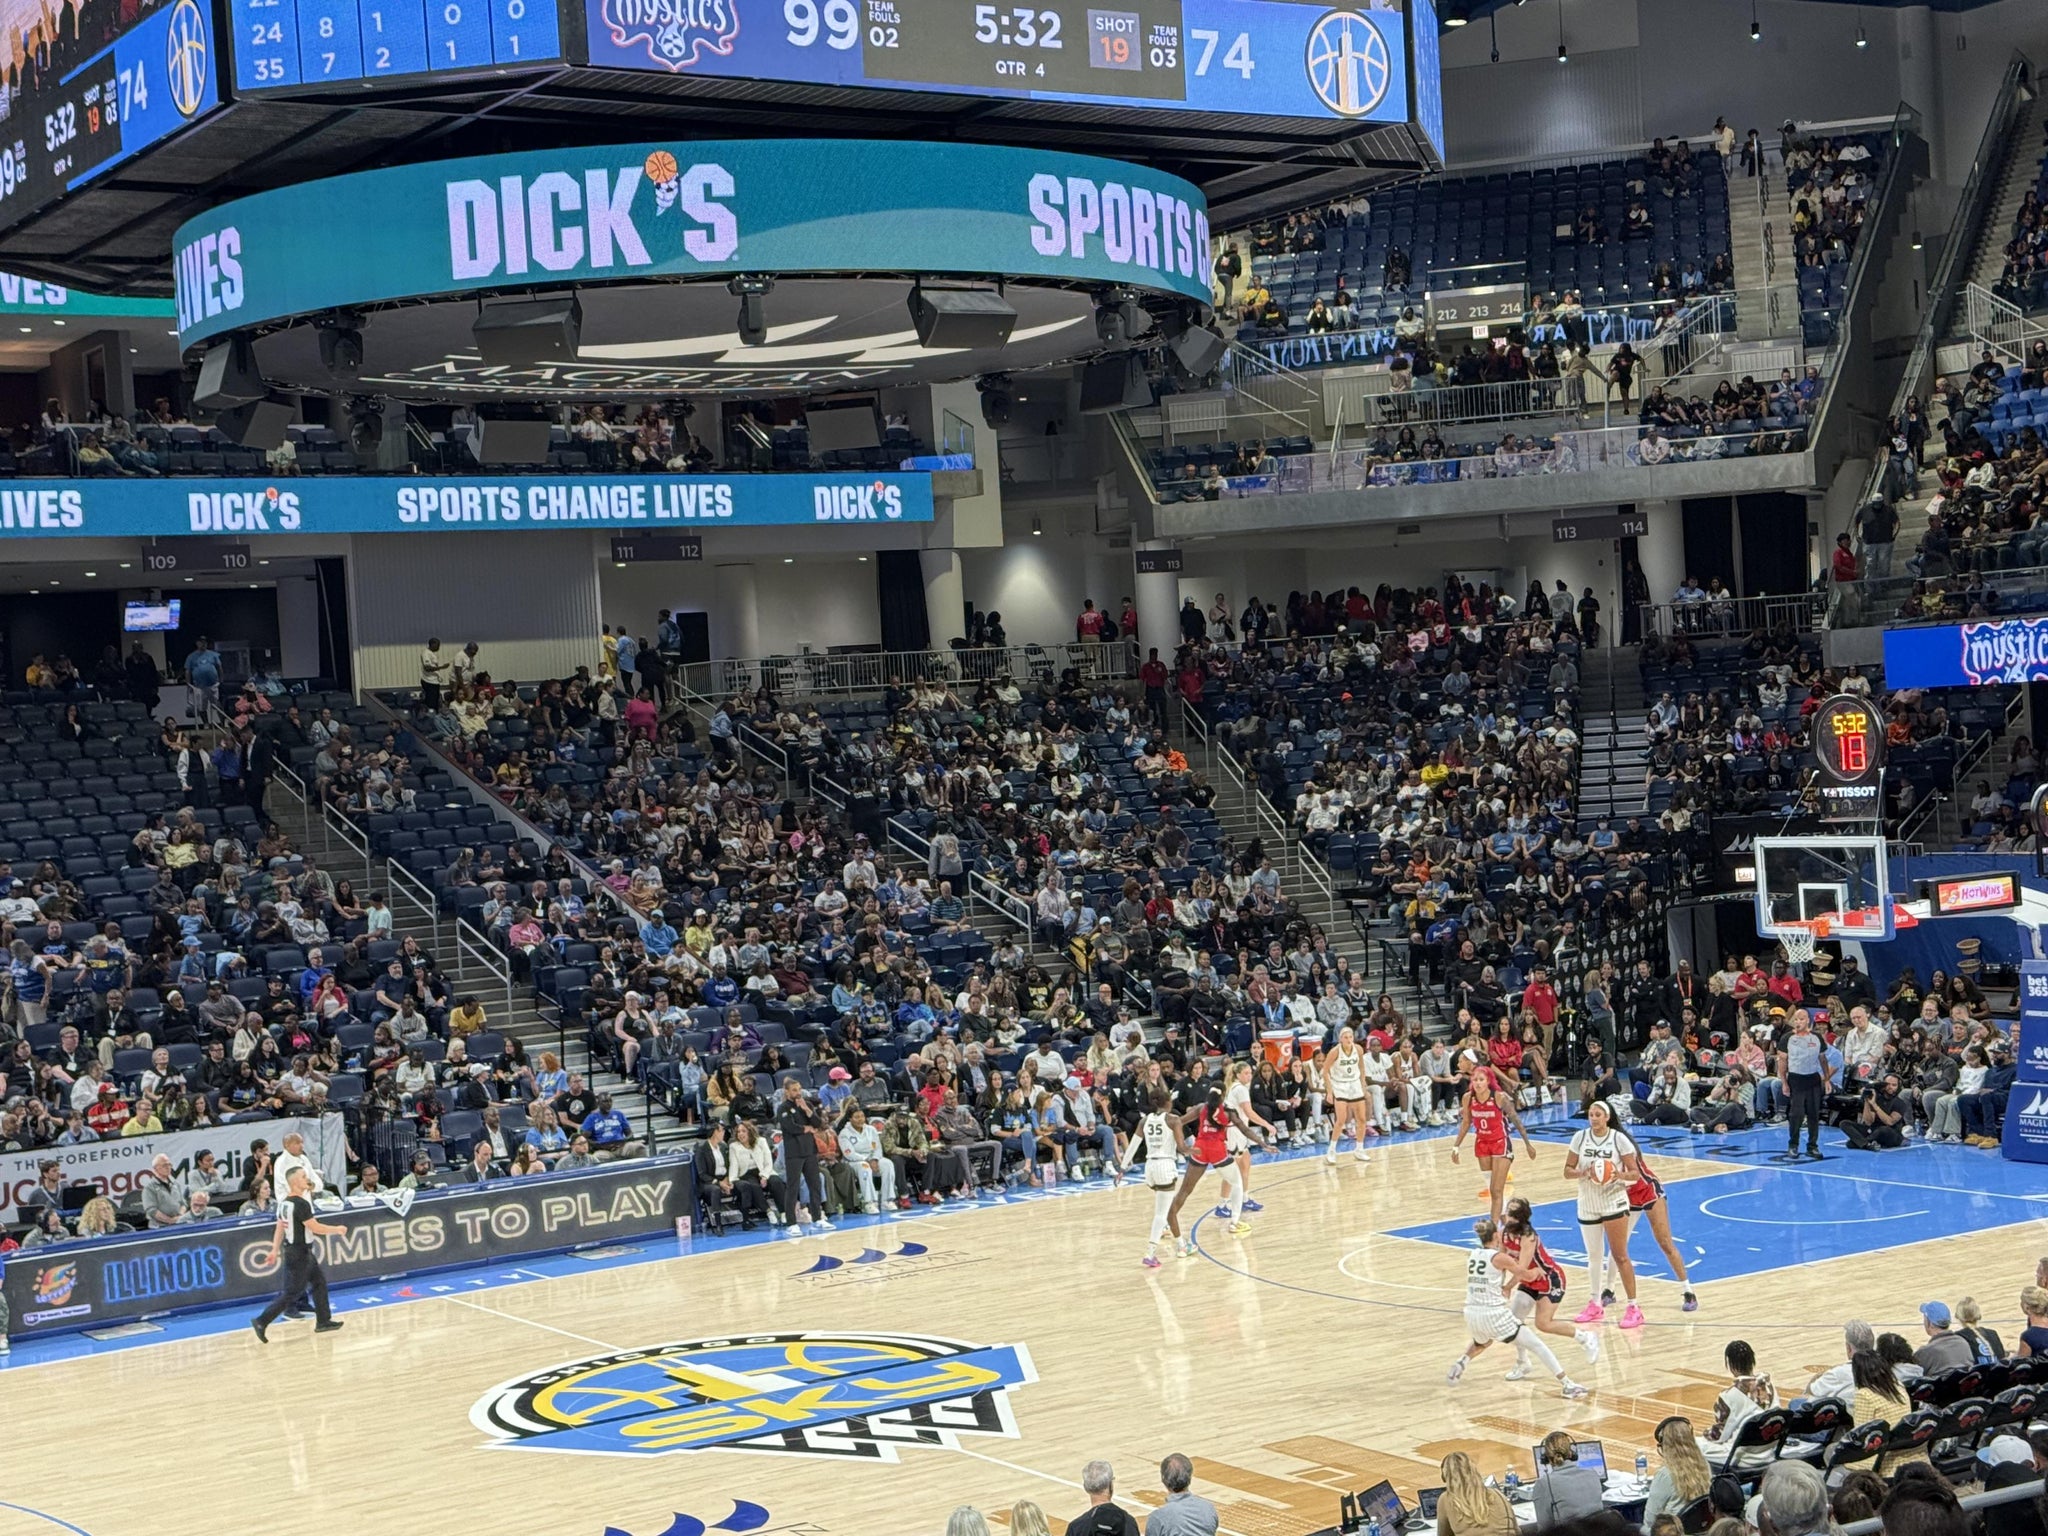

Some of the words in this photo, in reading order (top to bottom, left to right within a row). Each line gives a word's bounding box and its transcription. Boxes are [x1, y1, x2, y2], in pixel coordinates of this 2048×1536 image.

[867, 1, 894, 12] TEAM
[869, 11, 900, 23] FOULS
[251, 22, 283, 45] 24
[319, 17, 334, 38] 8
[372, 11, 383, 33] 1
[444, 4, 462, 25] 0
[784, 0, 859, 50] 99
[974, 4, 1063, 49] 5:32
[1096, 17, 1135, 33] SHOT
[1154, 25, 1177, 37] TEAM
[869, 26, 899, 48] 02
[1149, 35, 1178, 47] FOULS
[254, 58, 285, 81] 35
[321, 52, 336, 74] 7
[376, 48, 391, 69] 2
[446, 40, 456, 61] 1
[509, 35, 520, 56] 1
[1101, 36, 1130, 63] 19
[1150, 48, 1177, 68] 03
[1190, 28, 1256, 80] 74
[995, 60, 1026, 76] QTR
[1035, 62, 1046, 77] 4
[119, 60, 147, 122] 74
[87, 106, 99, 134] 19
[105, 101, 117, 126] 03
[45, 101, 77, 152] 5:32
[16, 161, 27, 183] 02
[446, 150, 739, 280] DICK'S
[1028, 172, 1194, 279] SPORTS
[175, 226, 245, 334] LIVES
[1437, 309, 1458, 321] 212
[1469, 306, 1489, 318] 213
[1500, 302, 1522, 315] 214
[0, 490, 83, 528] IVES
[188, 487, 301, 532] DICK'S
[397, 486, 520, 523] SPORTS
[527, 485, 647, 520] CHANGE
[653, 483, 733, 519] LIVES
[813, 480, 902, 520] DICK'S
[1556, 524, 1578, 541] 113
[1622, 519, 1645, 535] 114
[148, 555, 177, 570] 109
[222, 553, 247, 568] 110
[616, 545, 634, 560] 111
[679, 543, 699, 559] 112
[1141, 560, 1156, 571] 112
[1167, 559, 1181, 570] 113
[1833, 713, 1868, 736] 5:32
[1840, 735, 1867, 771] 18
[1838, 786, 1876, 797] TISSOT
[2027, 974, 2048, 987] bet
[2028, 986, 2048, 997] 365
[1147, 1124, 1163, 1136] 35
[1480, 1118, 1488, 1130] 0
[2019, 1118, 2048, 1128] MAGEL
[55, 1143, 155, 1167] FOREFRONT
[1584, 1148, 1613, 1158] SKY
[104, 1246, 224, 1303] ILLINOIS
[239, 1215, 445, 1279] CMES
[456, 1202, 531, 1245] TO
[541, 1180, 673, 1233] PLAY
[1468, 1259, 1487, 1276] 22
[529, 1335, 777, 1385] CHICAGO
[620, 1360, 1002, 1449] SKY
